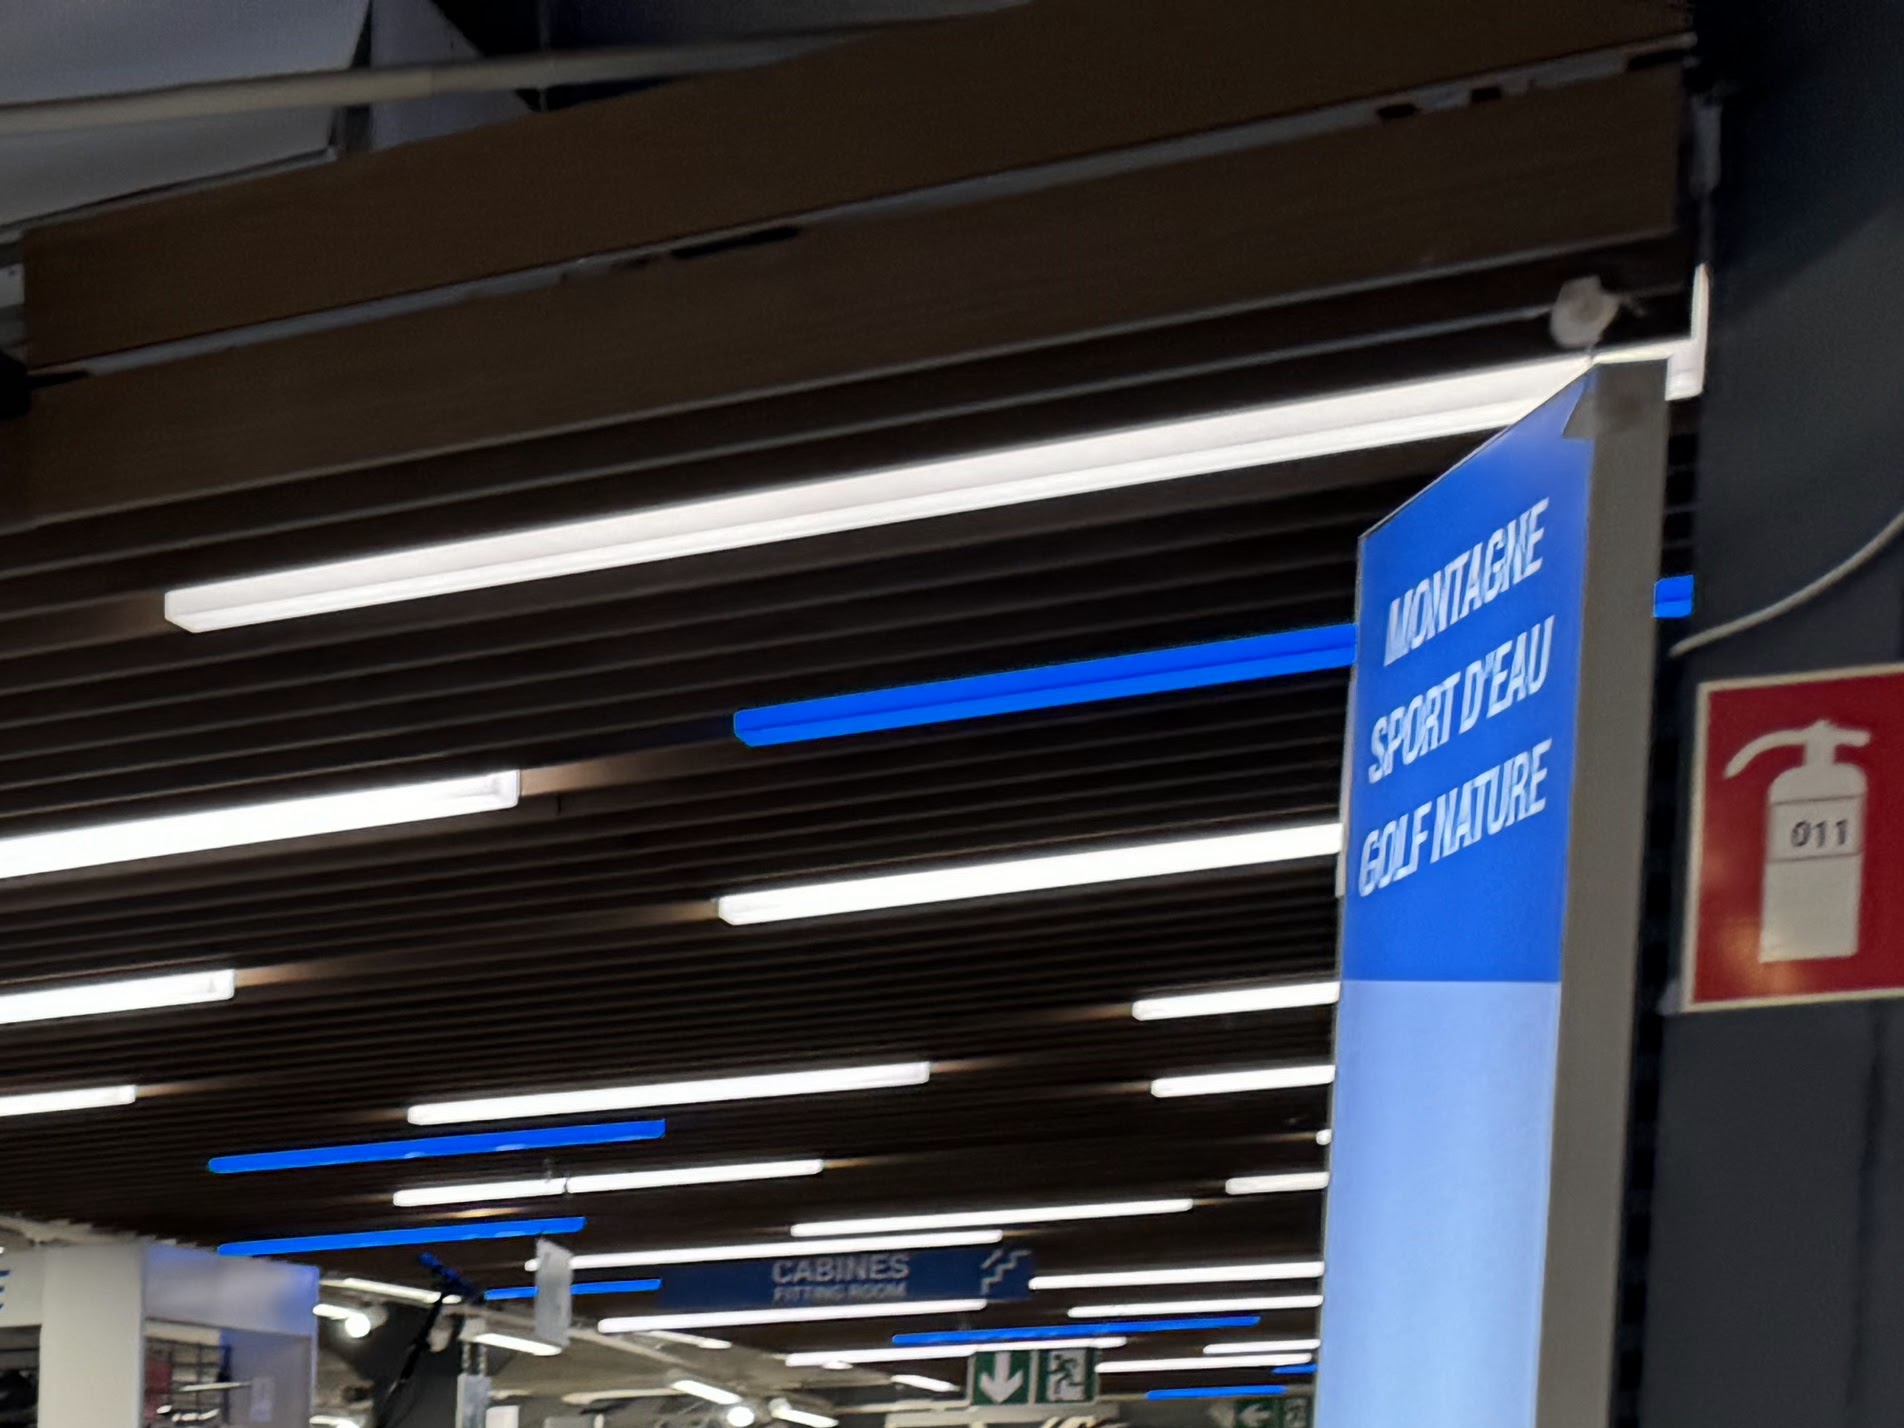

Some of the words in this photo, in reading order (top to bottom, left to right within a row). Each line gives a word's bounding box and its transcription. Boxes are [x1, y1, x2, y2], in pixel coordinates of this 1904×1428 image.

[1383, 497, 1550, 668] MONTAGNE
[1368, 670, 1460, 785] SPORT
[1458, 614, 1556, 735] D'EAU
[1357, 801, 1432, 898] GOLF
[1430, 738, 1553, 864] NATURE
[771, 1253, 911, 1284] CABINES
